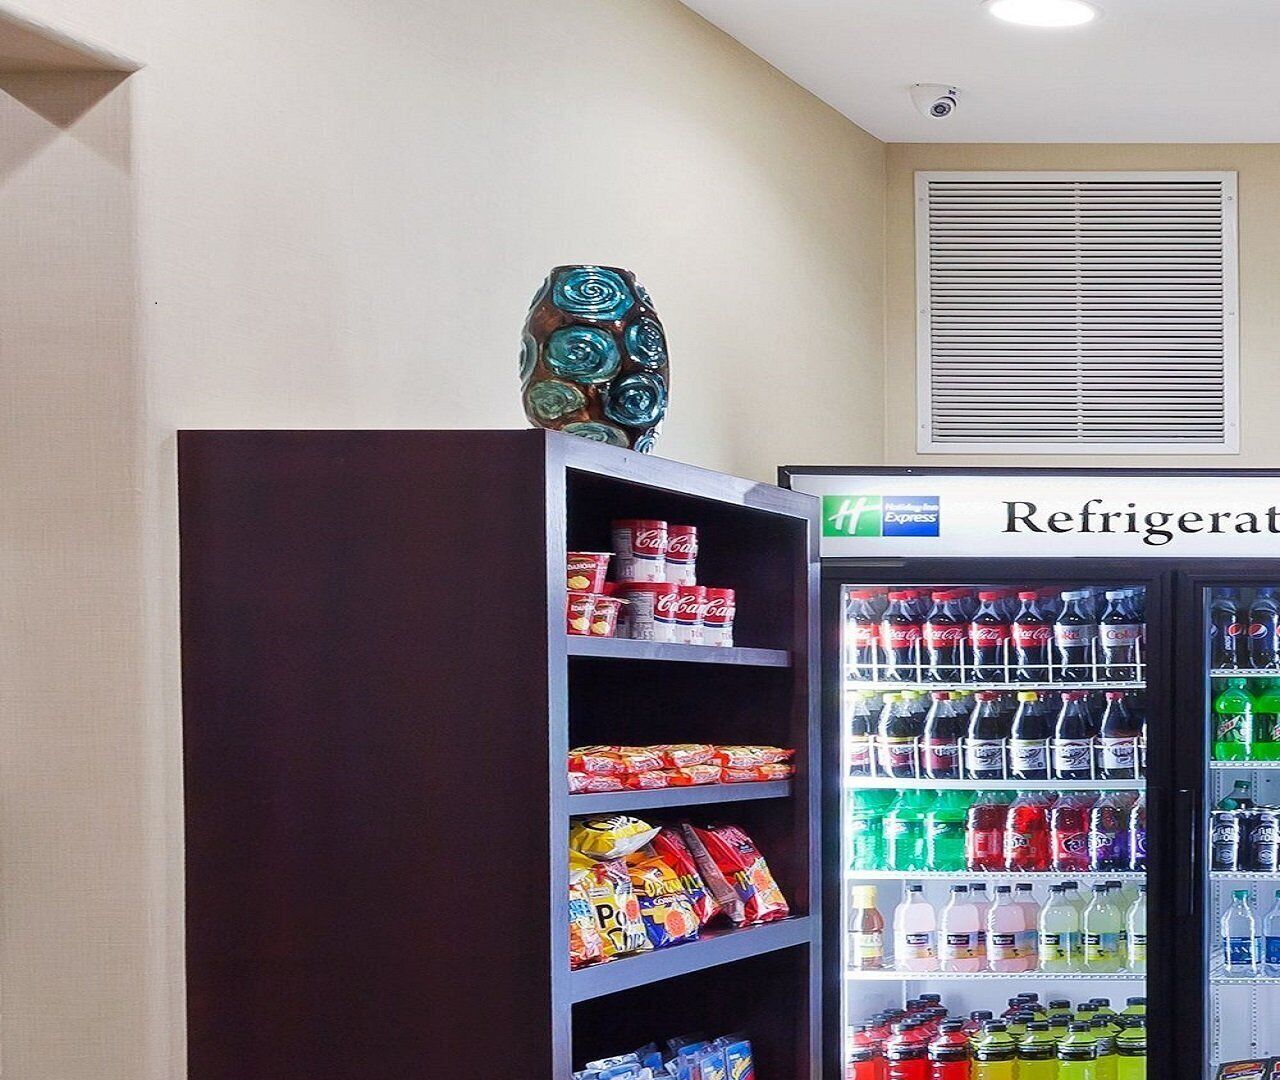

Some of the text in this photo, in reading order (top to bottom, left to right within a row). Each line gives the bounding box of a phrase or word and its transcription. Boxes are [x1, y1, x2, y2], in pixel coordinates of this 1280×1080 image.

[884, 503, 939, 513] Holiday Inn
[885, 512, 938, 524] Express
